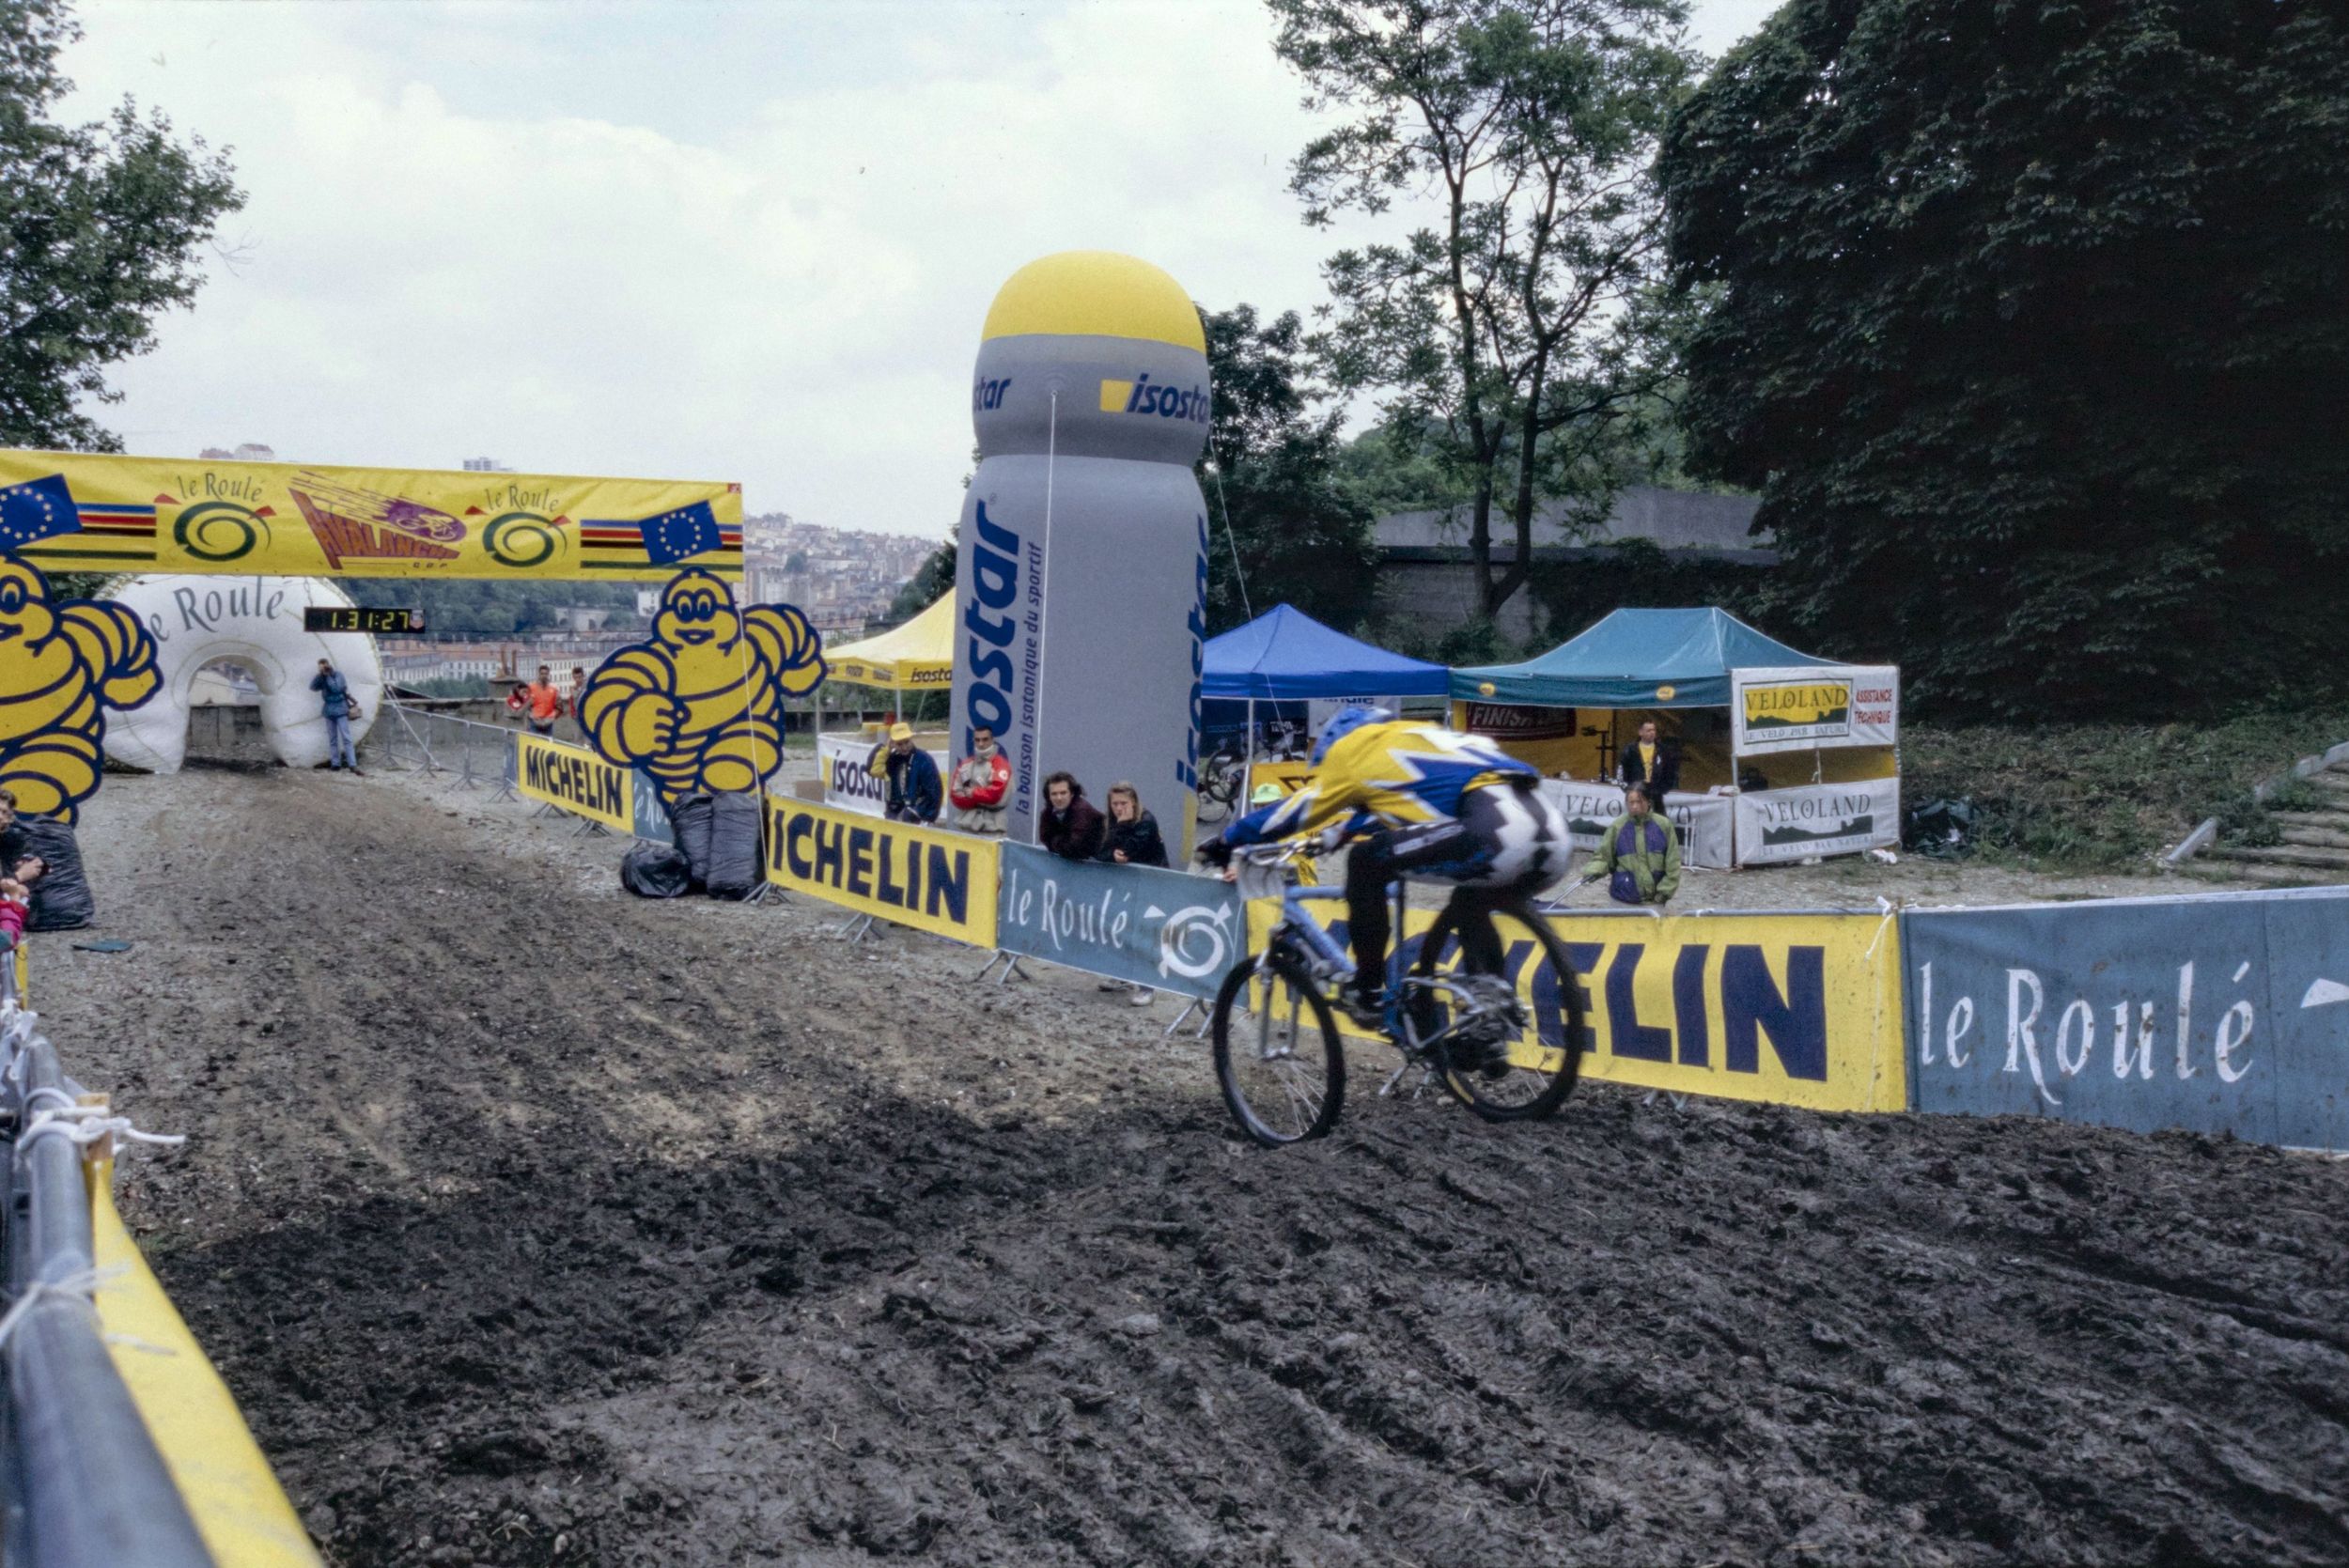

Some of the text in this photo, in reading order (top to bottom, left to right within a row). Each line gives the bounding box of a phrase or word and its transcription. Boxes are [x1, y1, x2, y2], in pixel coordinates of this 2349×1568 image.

[1127, 373, 1209, 423] isosta
[178, 474, 197, 500] le
[484, 488, 502, 511] le
[910, 667, 952, 683] isosta
[1016, 541, 1043, 815] la boisson isotonique du sportif
[1745, 688, 1849, 711] VELOLAND
[1856, 689, 1892, 704] ASSISTANCE
[1854, 710, 1891, 725] TECHNIQUE
[526, 744, 623, 819] MICHELIN
[1764, 793, 1872, 823] VELOLAND
[770, 809, 971, 925] ICHELIN
[1008, 868, 1131, 951] le Roulé
[1919, 959, 2254, 1105] le Roulé
